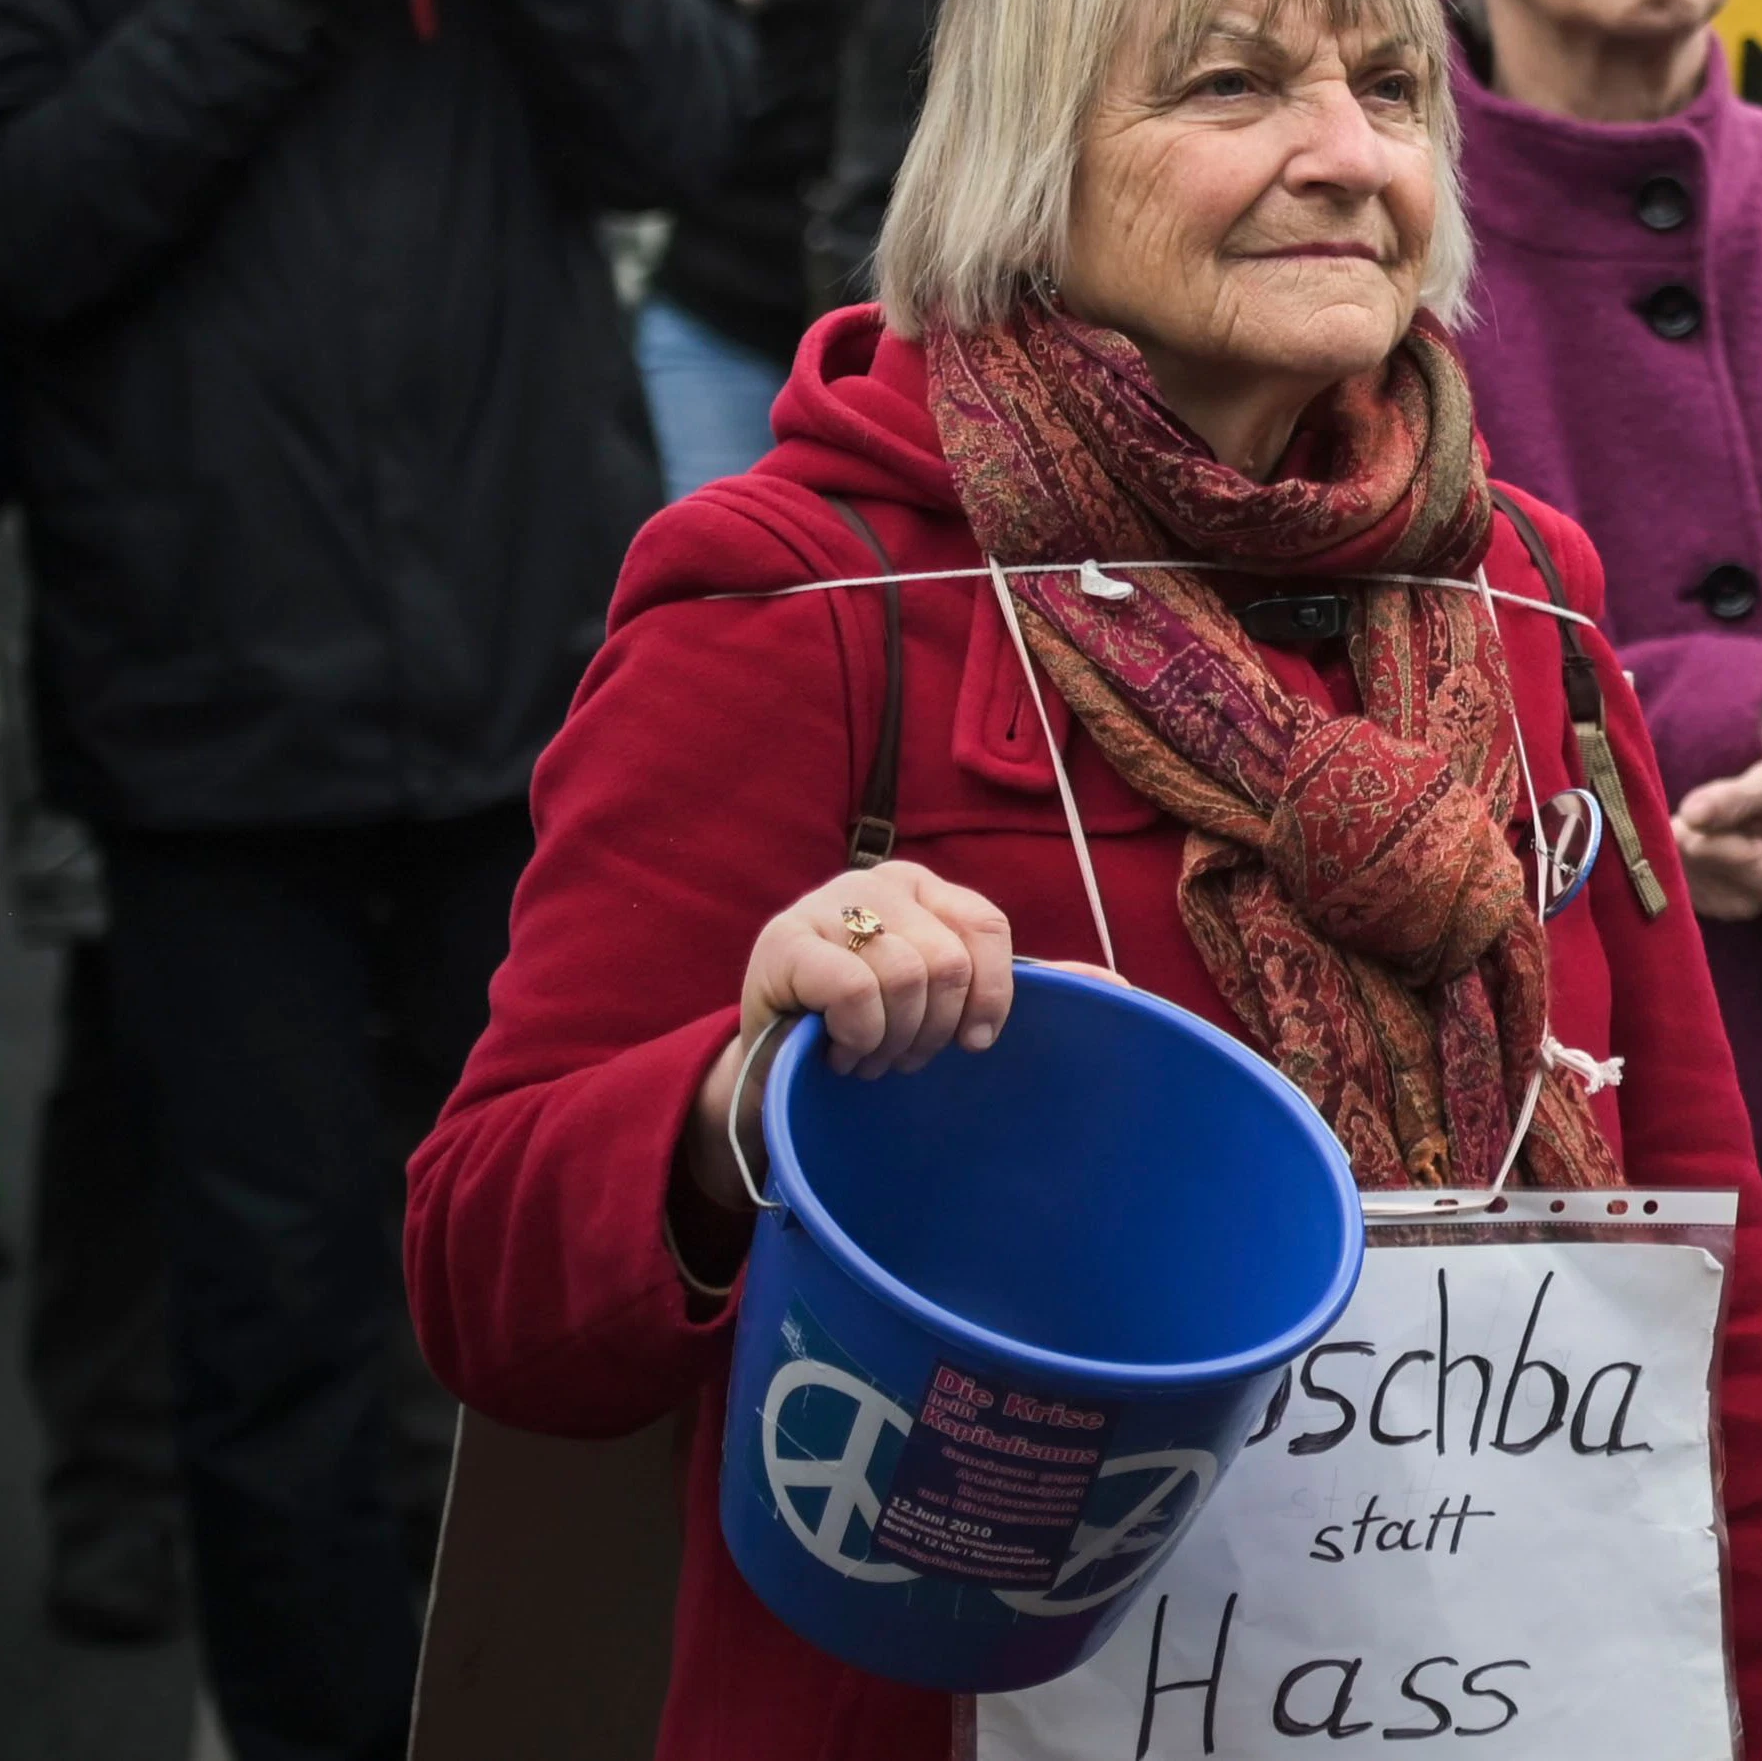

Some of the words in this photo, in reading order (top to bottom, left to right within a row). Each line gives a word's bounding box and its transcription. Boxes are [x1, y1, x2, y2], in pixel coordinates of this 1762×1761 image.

[933, 1365, 994, 1409] Die
[1003, 1392, 1105, 1431] Krise
[920, 1403, 1099, 1465] Kapitalismus
[882, 1518, 914, 1541] Berlin
[923, 1536, 938, 1549] 12
[940, 1542, 961, 1557] Uhr
[949, 1519, 993, 1538] 2010
[955, 1534, 1035, 1555] Demonstration
[1310, 1494, 1496, 1563] statt
[1135, 1592, 1532, 1761] Hass
